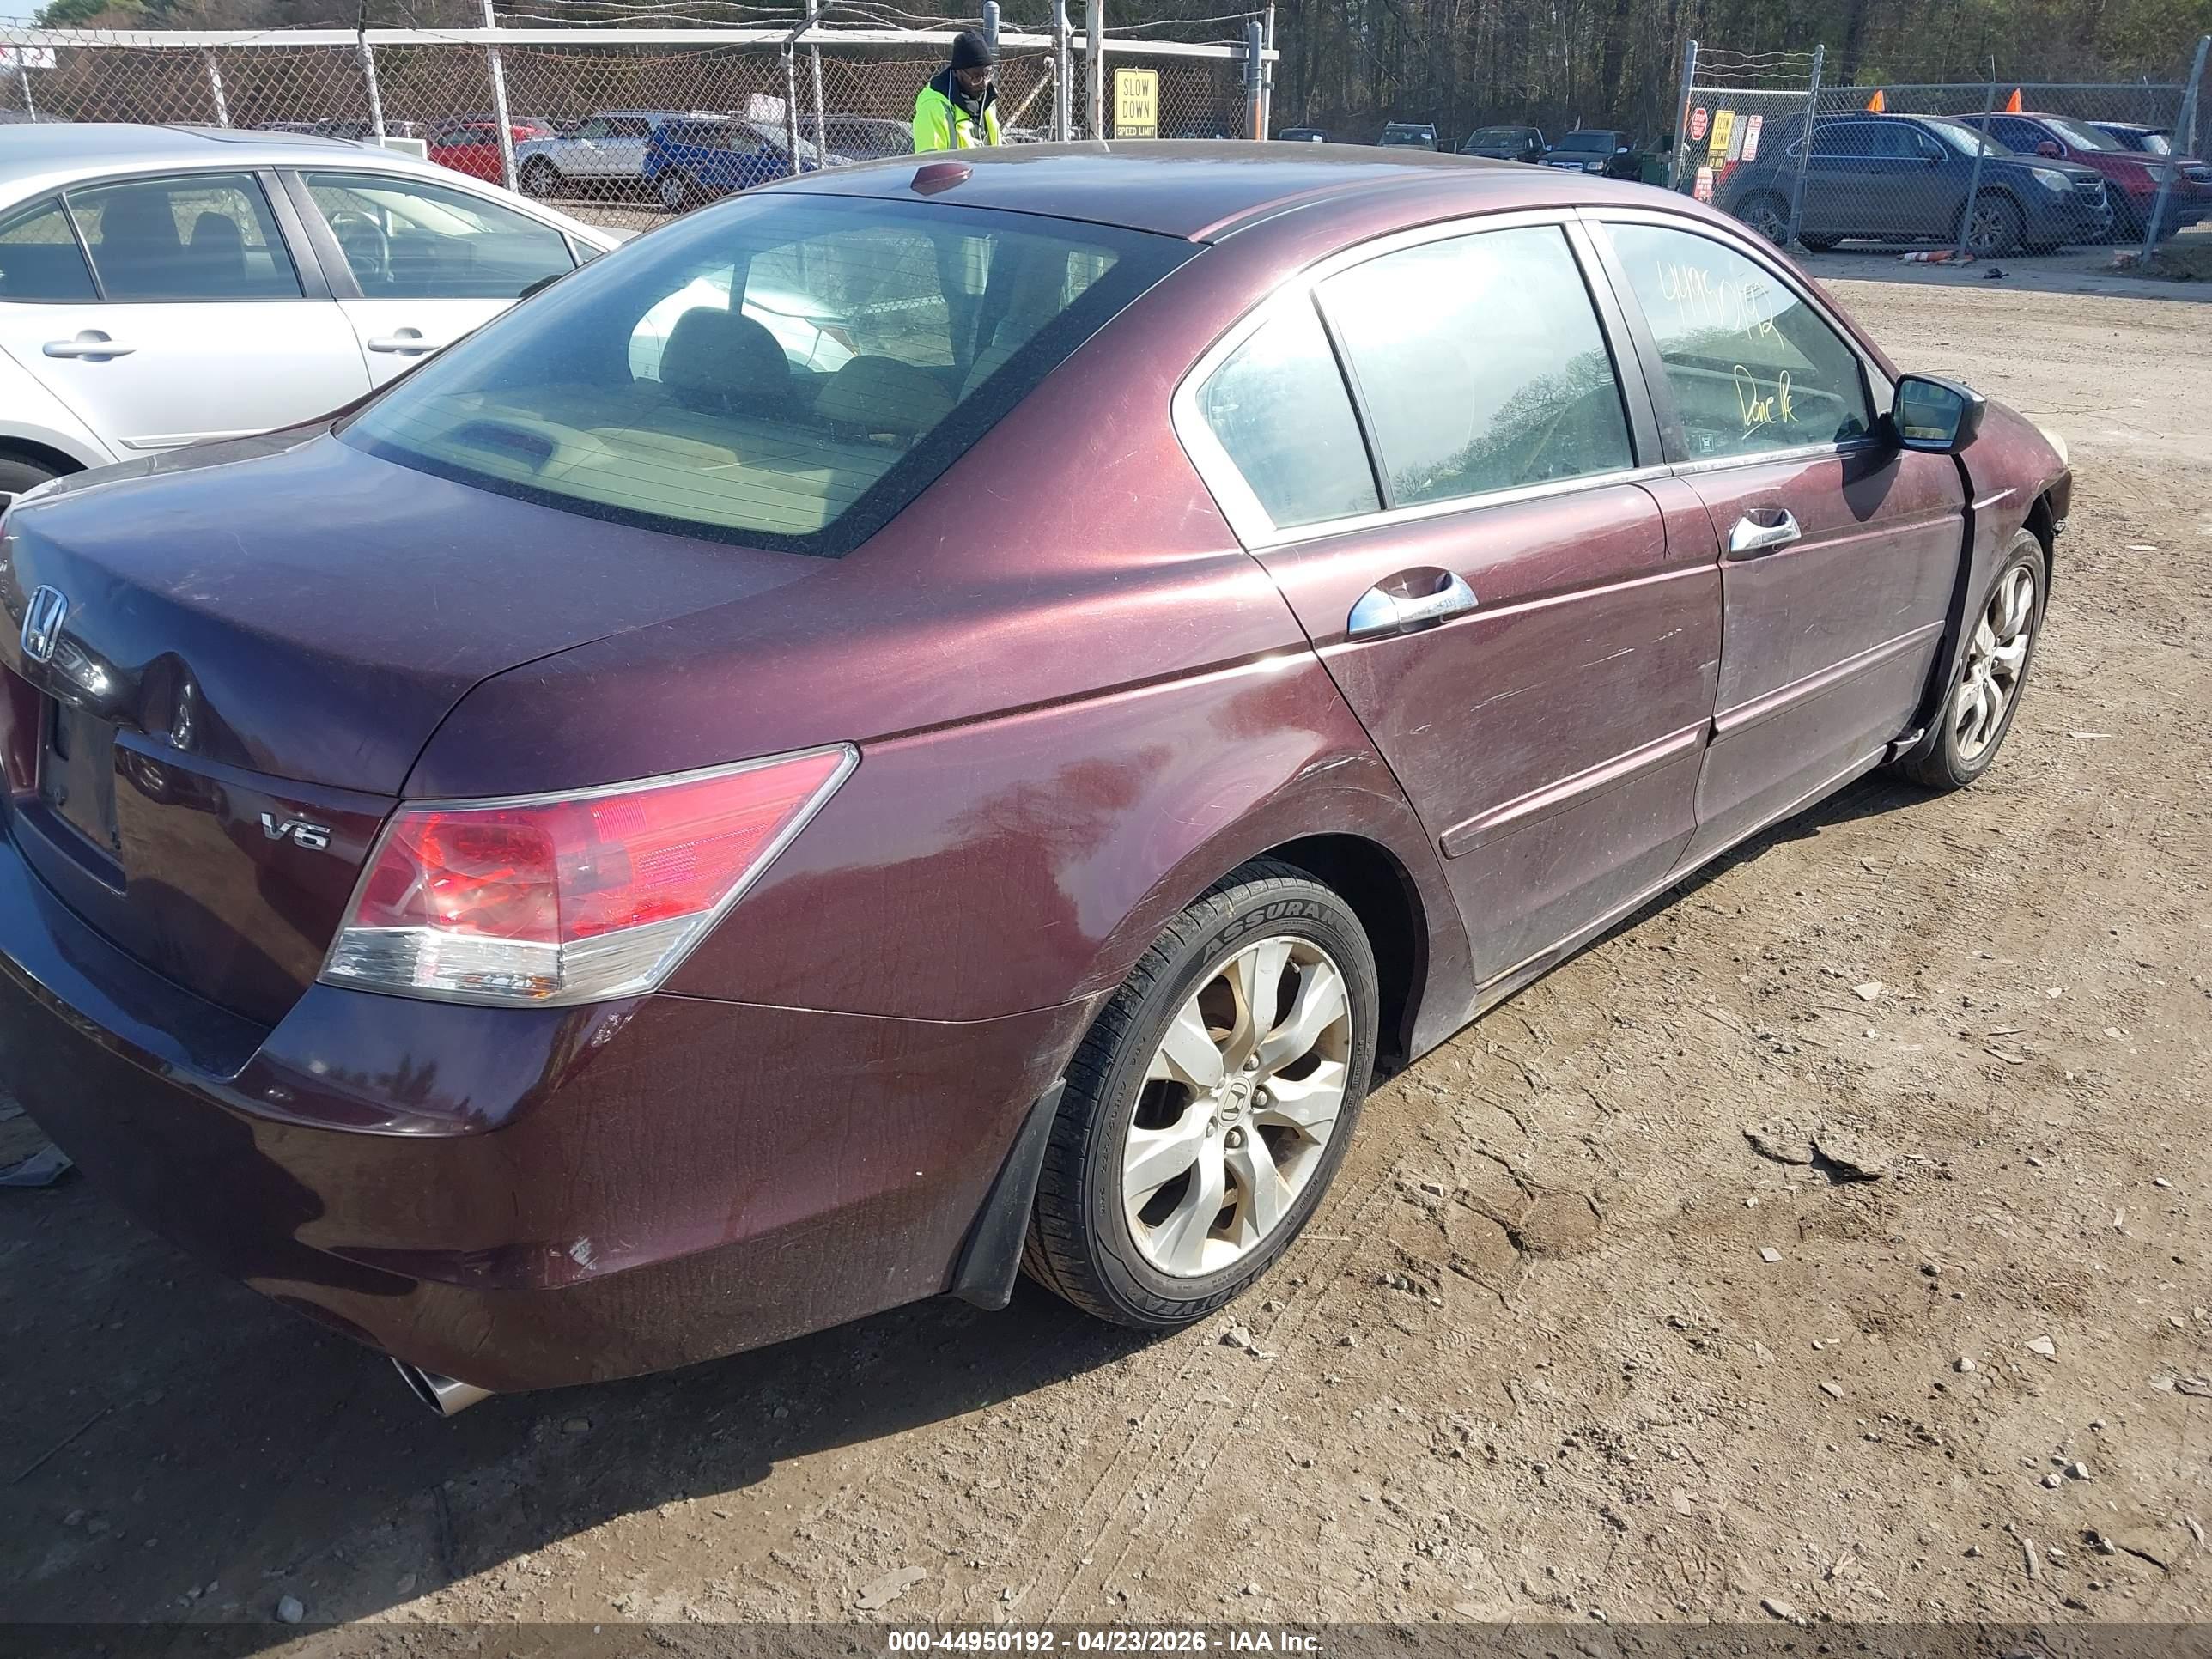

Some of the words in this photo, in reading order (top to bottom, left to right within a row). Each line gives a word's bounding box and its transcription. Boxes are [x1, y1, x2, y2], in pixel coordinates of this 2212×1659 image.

[1123, 77, 1150, 96] SLOW
[1122, 100, 1151, 118] DOWN
[1117, 126, 1137, 137] SPEED
[1139, 126, 1155, 137] LIMIT
[1717, 117, 1730, 130] SLOW
[1713, 131, 1728, 145] DOWN
[1734, 365, 1776, 426] Done
[261, 812, 331, 851] V6
